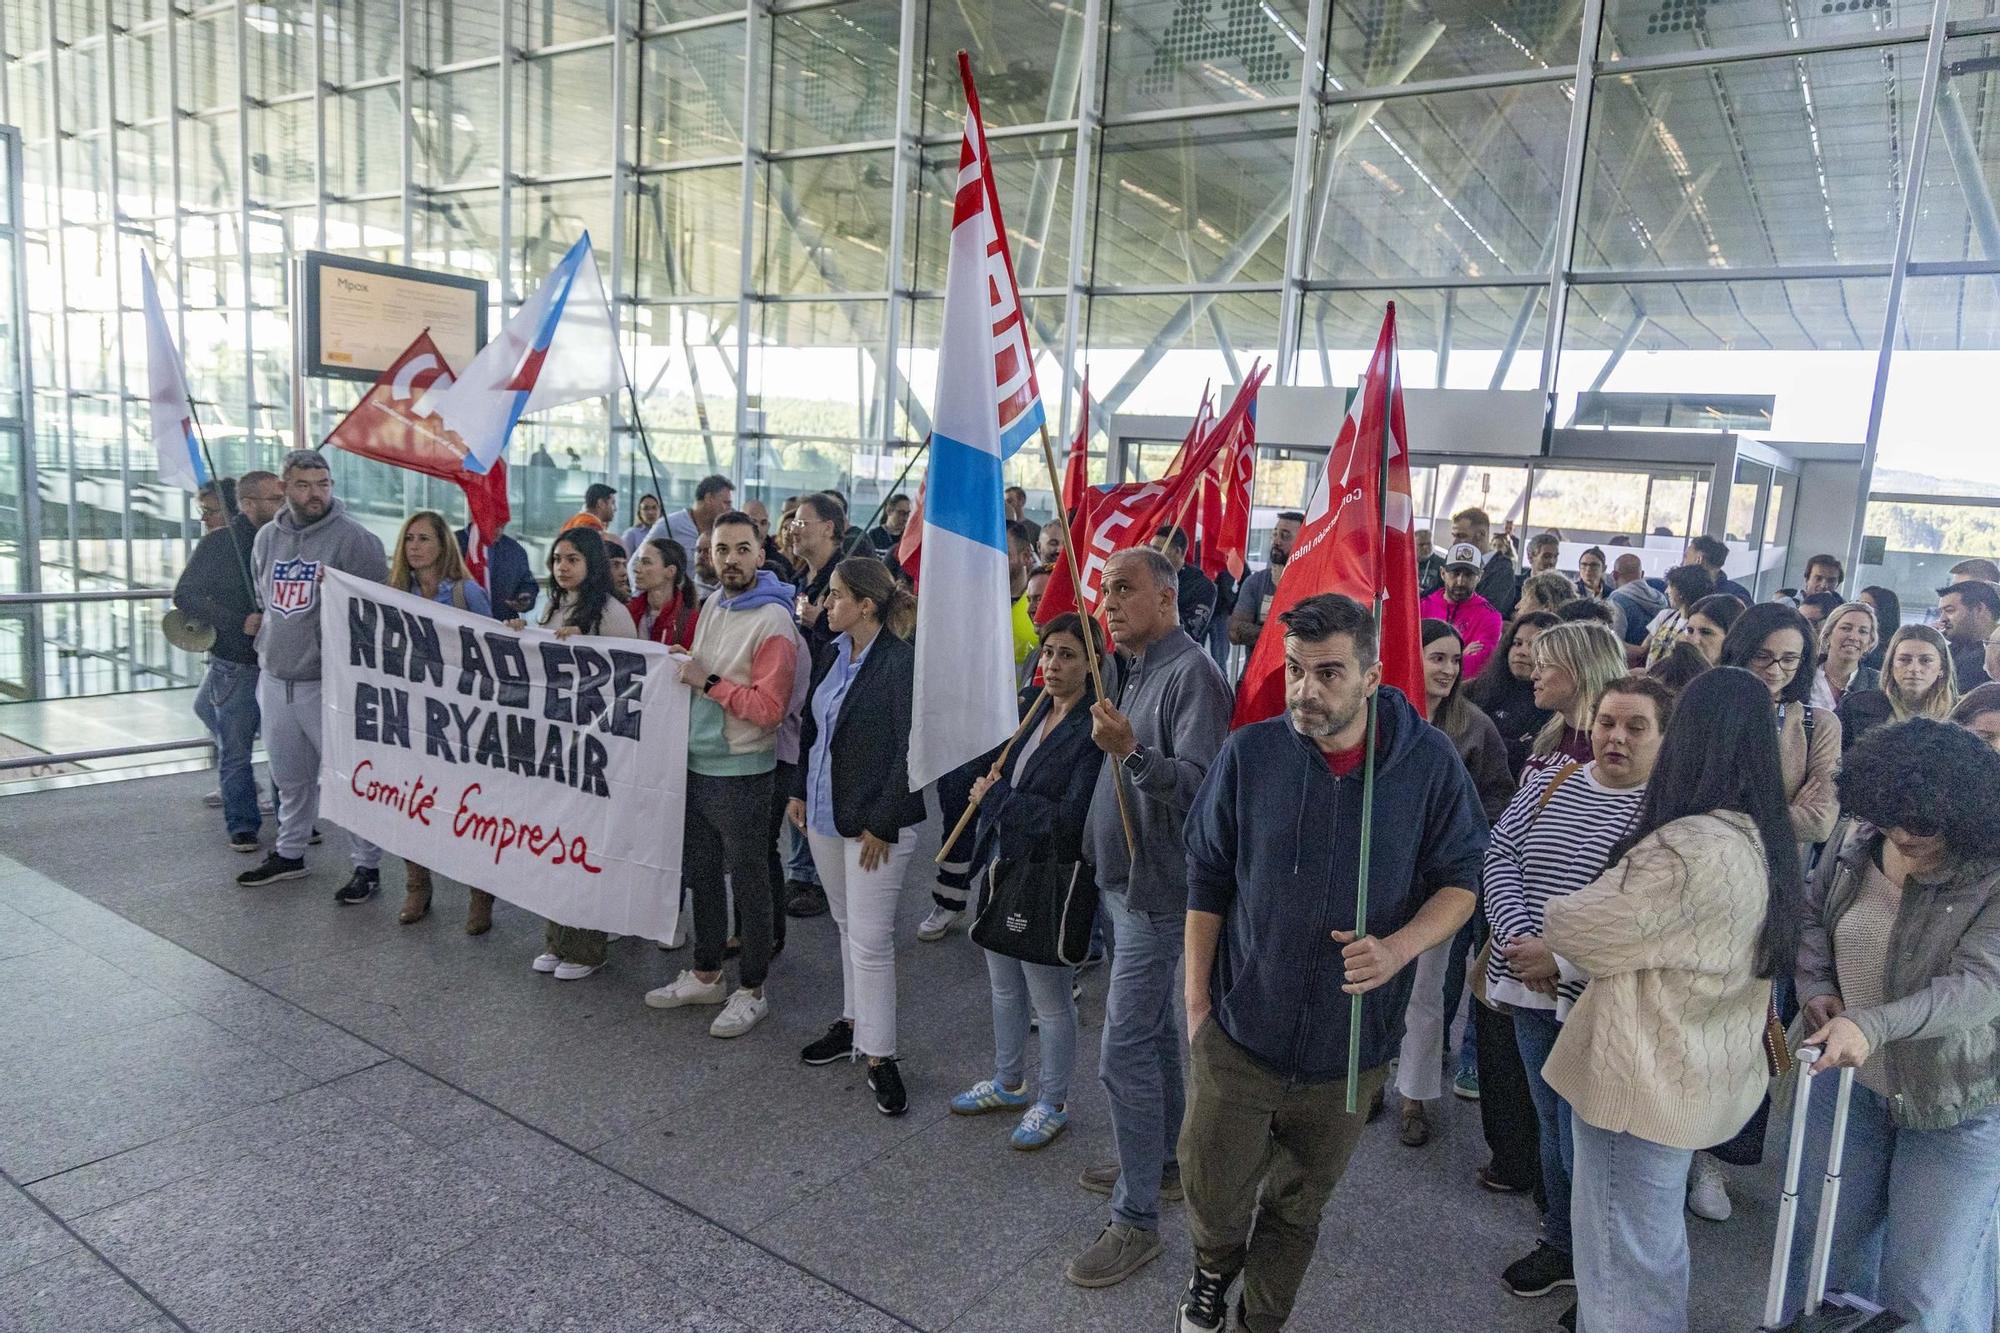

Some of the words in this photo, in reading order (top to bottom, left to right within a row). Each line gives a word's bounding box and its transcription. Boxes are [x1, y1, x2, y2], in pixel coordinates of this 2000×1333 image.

[337, 277, 369, 293] Mpox
[274, 581, 309, 608] NFL
[349, 597, 444, 688] NON
[457, 625, 530, 710] AO
[539, 641, 648, 742] ERE
[354, 682, 411, 750] EN
[426, 697, 611, 799] RYANAIR
[351, 759, 436, 827] Comité
[453, 783, 603, 874] Empresa
